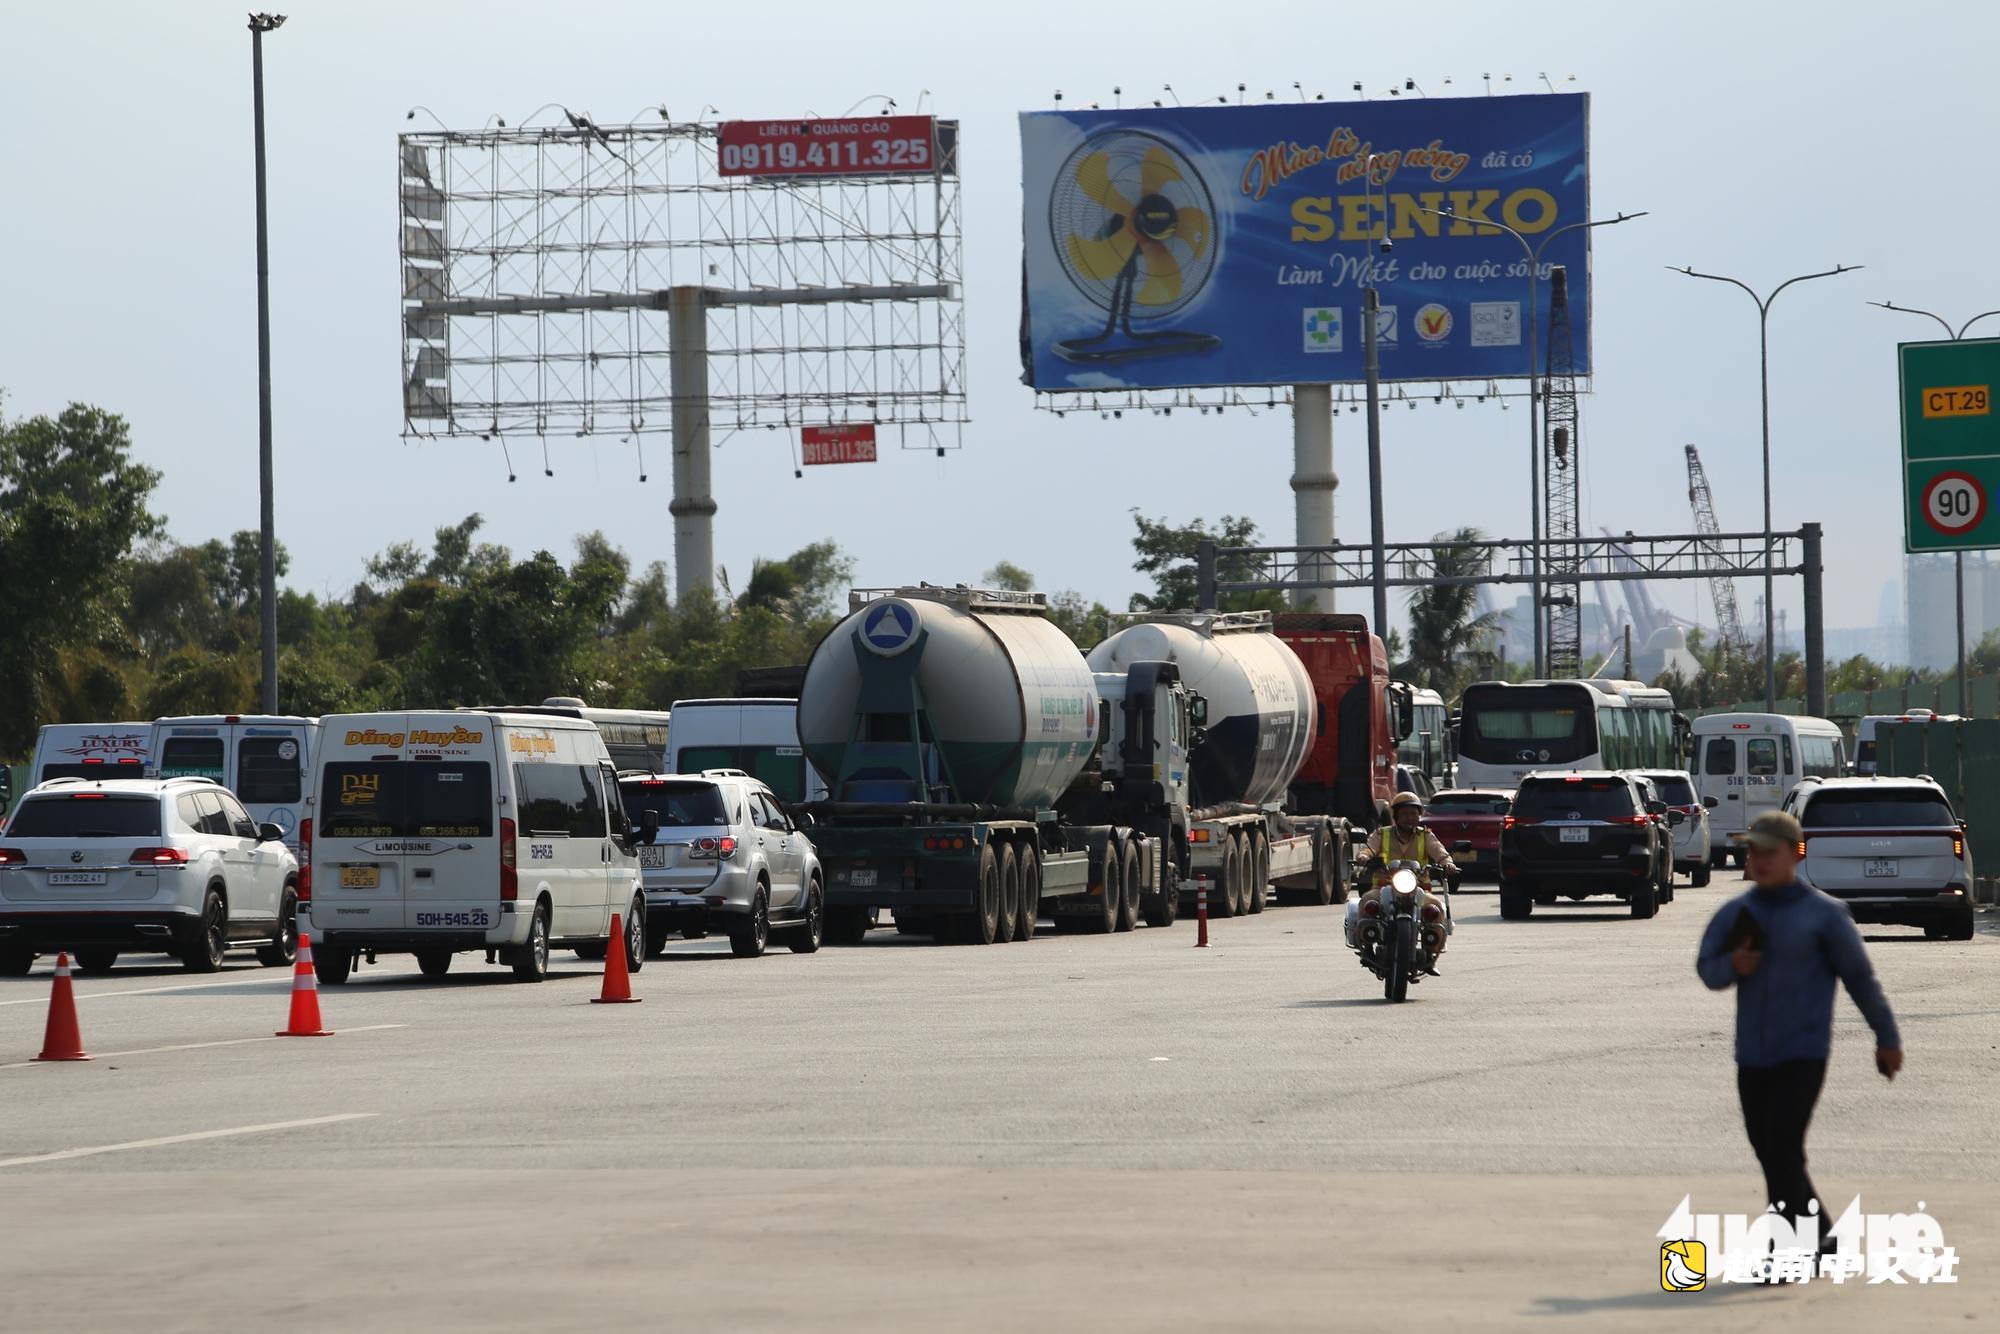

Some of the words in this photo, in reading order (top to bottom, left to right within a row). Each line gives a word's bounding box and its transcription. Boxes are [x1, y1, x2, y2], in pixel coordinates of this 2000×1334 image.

[759, 122, 788, 136] LIÊN
[792, 121, 808, 136] H
[723, 138, 929, 170] 0919.411.325
[1241, 141, 1323, 200] Mùa
[1324, 127, 1360, 159] hè
[1402, 139, 1471, 183] nóng
[1481, 151, 1507, 169] đã
[1511, 150, 1533, 168] có
[1291, 187, 1559, 242] SENKO
[1277, 264, 1324, 286] Làm
[1329, 252, 1400, 288] Mát
[1409, 261, 1448, 281] cho
[1454, 259, 1502, 284] cuộc
[1929, 390, 1986, 412] CT.29
[1938, 488, 1971, 517] 90
[81, 739, 143, 748] LUXURY
[344, 729, 405, 748] Dũng
[408, 725, 483, 747] Huyền
[341, 774, 380, 791] DH
[343, 877, 374, 886] 545.26
[350, 868, 368, 877] 50H
[416, 912, 489, 926] 50H-545.26
